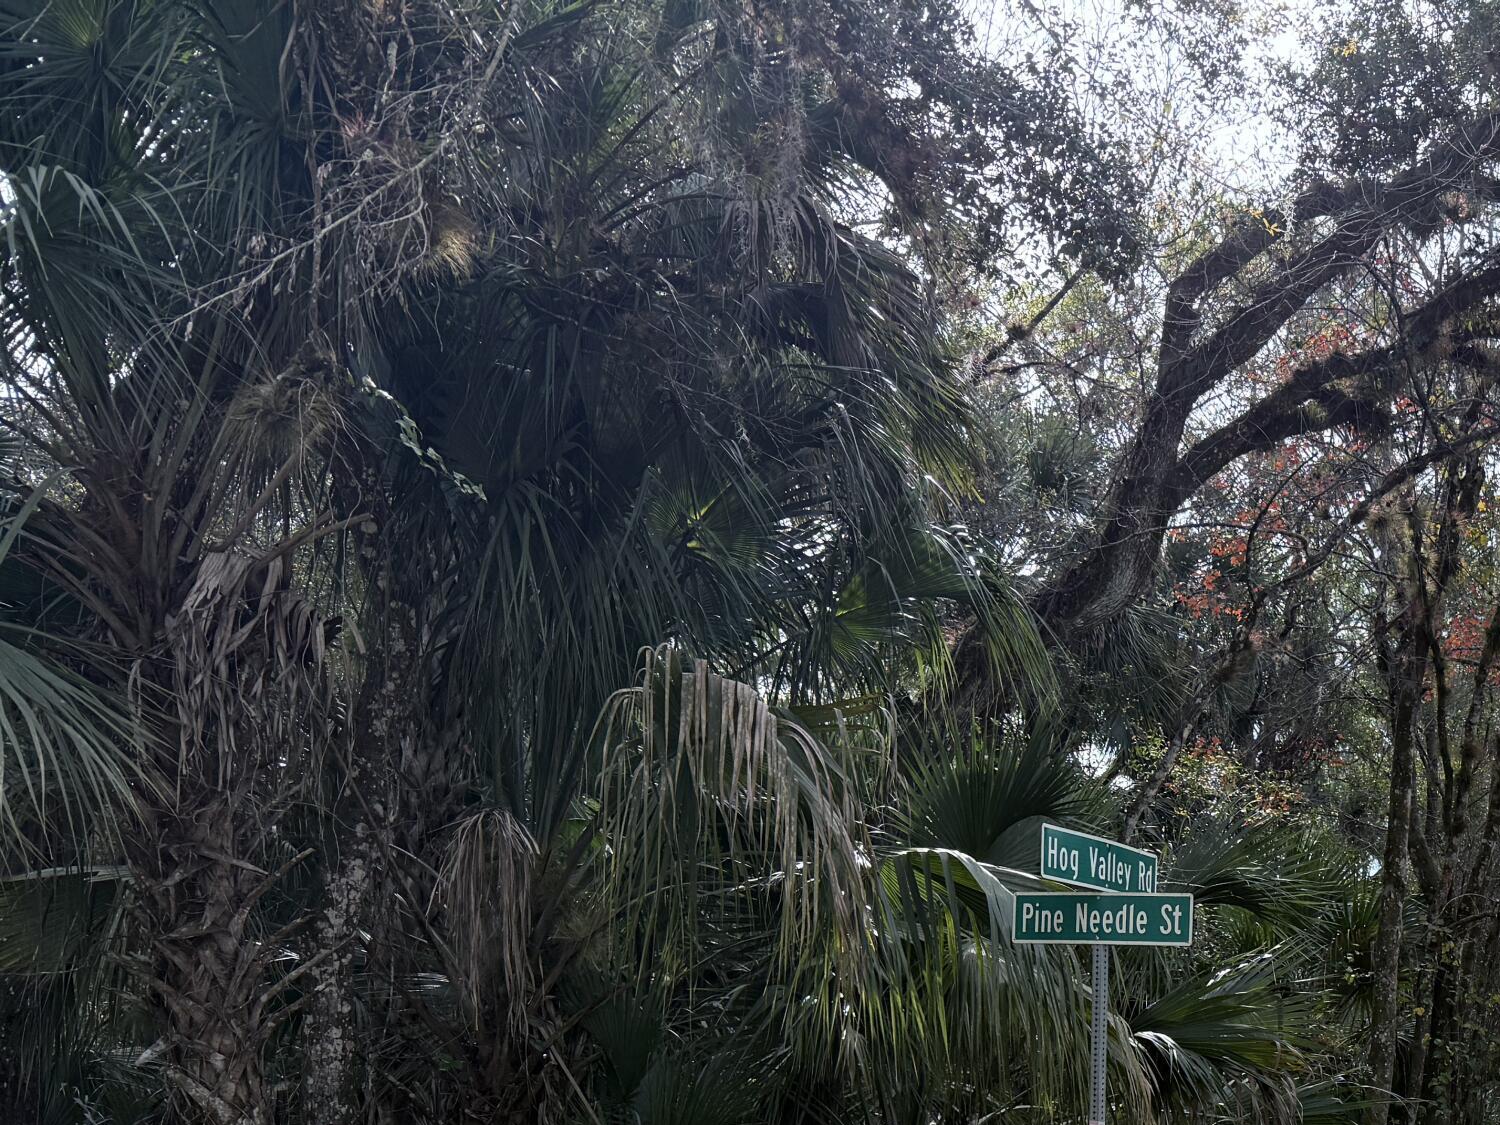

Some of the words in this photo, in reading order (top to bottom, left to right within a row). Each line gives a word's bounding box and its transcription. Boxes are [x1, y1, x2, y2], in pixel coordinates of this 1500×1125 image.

[1048, 836, 1079, 880] Hog
[1089, 846, 1132, 891] Valley
[1138, 861, 1153, 893] Rd
[1022, 903, 1064, 933] Pine
[1075, 903, 1148, 934] Needle
[1159, 904, 1183, 935] St
